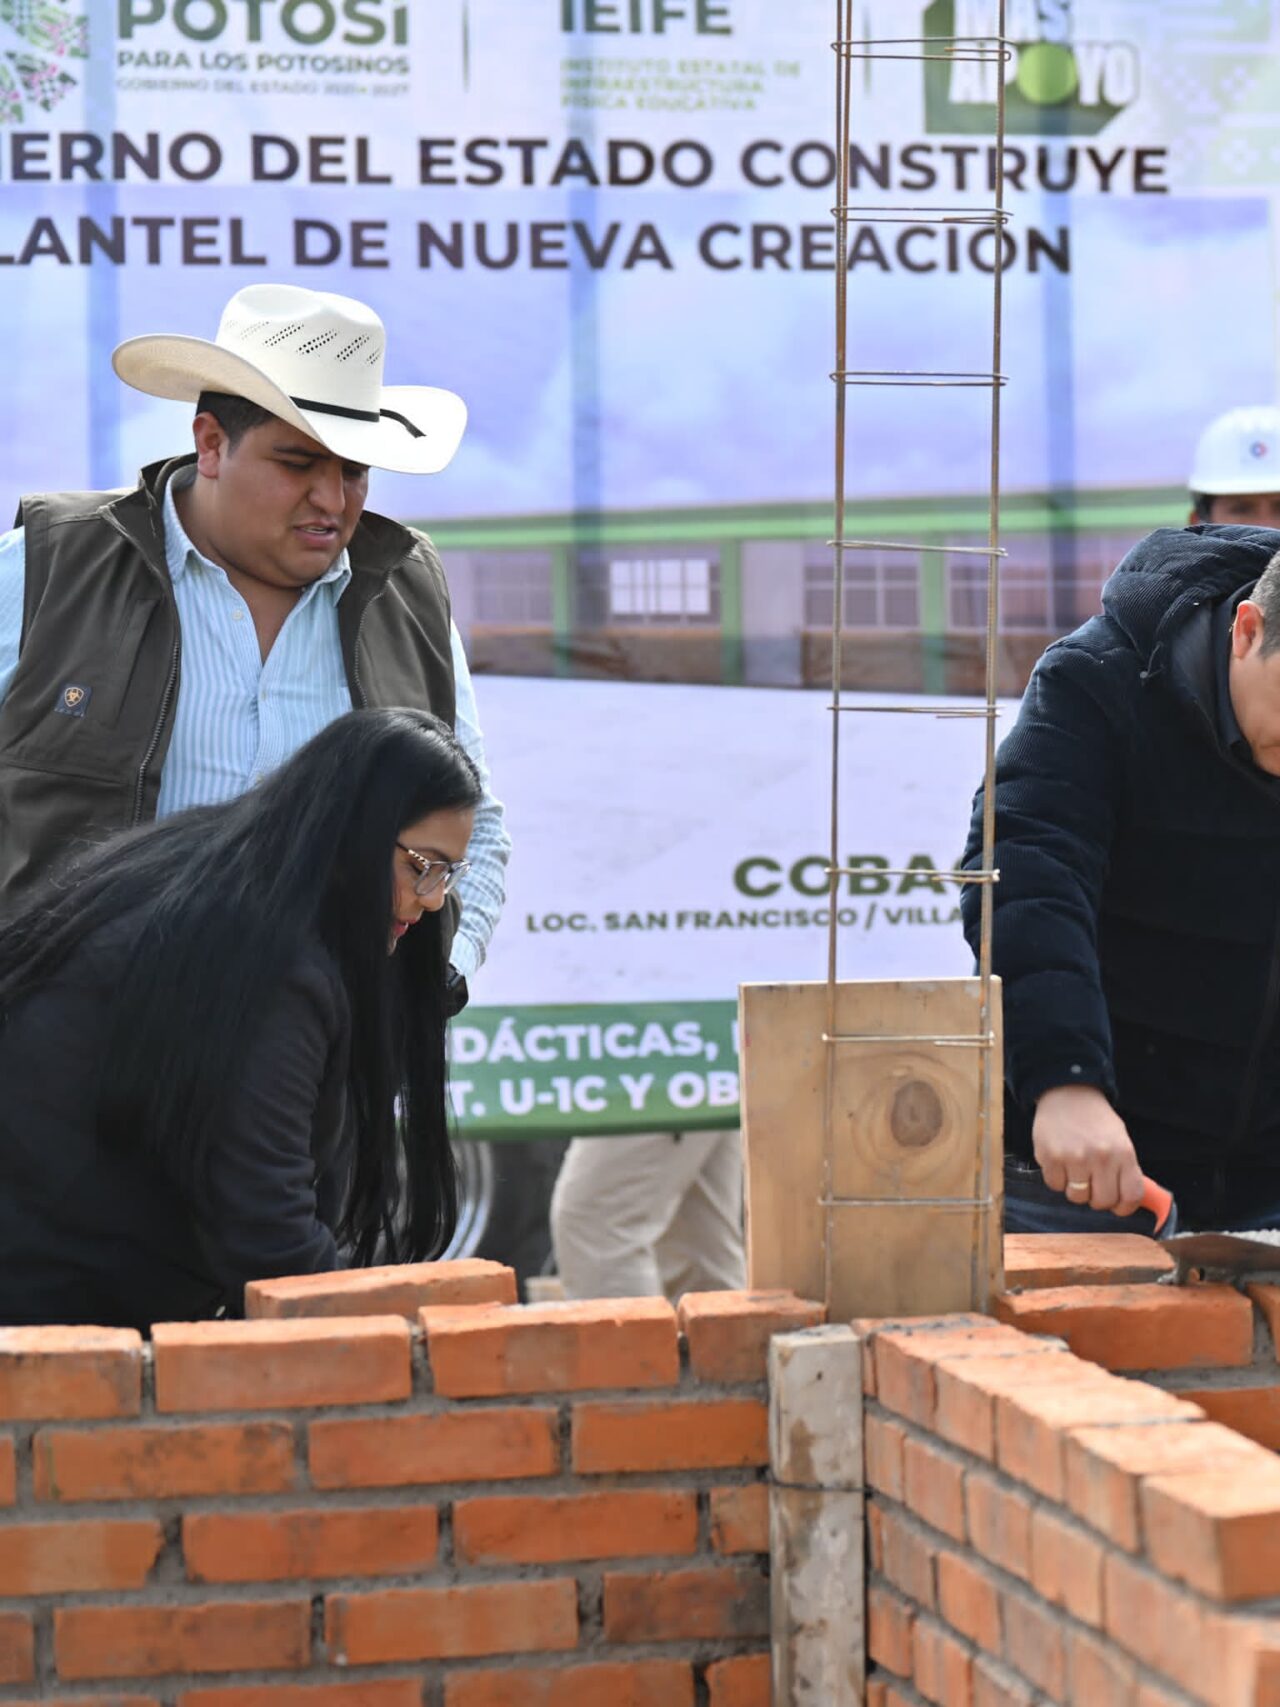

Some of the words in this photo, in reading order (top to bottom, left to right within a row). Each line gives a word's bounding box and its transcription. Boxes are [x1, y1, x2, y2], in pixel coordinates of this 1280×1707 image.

[561, 0, 733, 35] IEIFE
[118, 51, 192, 69] PARA
[200, 53, 248, 72] LOS
[257, 54, 410, 75] POTOSINOS
[0, 132, 223, 181] ERNO
[251, 135, 392, 184] DEL
[418, 138, 715, 187] ESTADO
[740, 140, 1170, 194] CONSTRUYE
[293, 219, 389, 268] DE
[418, 222, 673, 271] NUEVA
[733, 854, 961, 897] COBA
[526, 911, 595, 933] LOC.
[604, 910, 672, 930] SAN
[677, 906, 857, 929] FRANCISCO
[620, 1073, 654, 1110] Y
